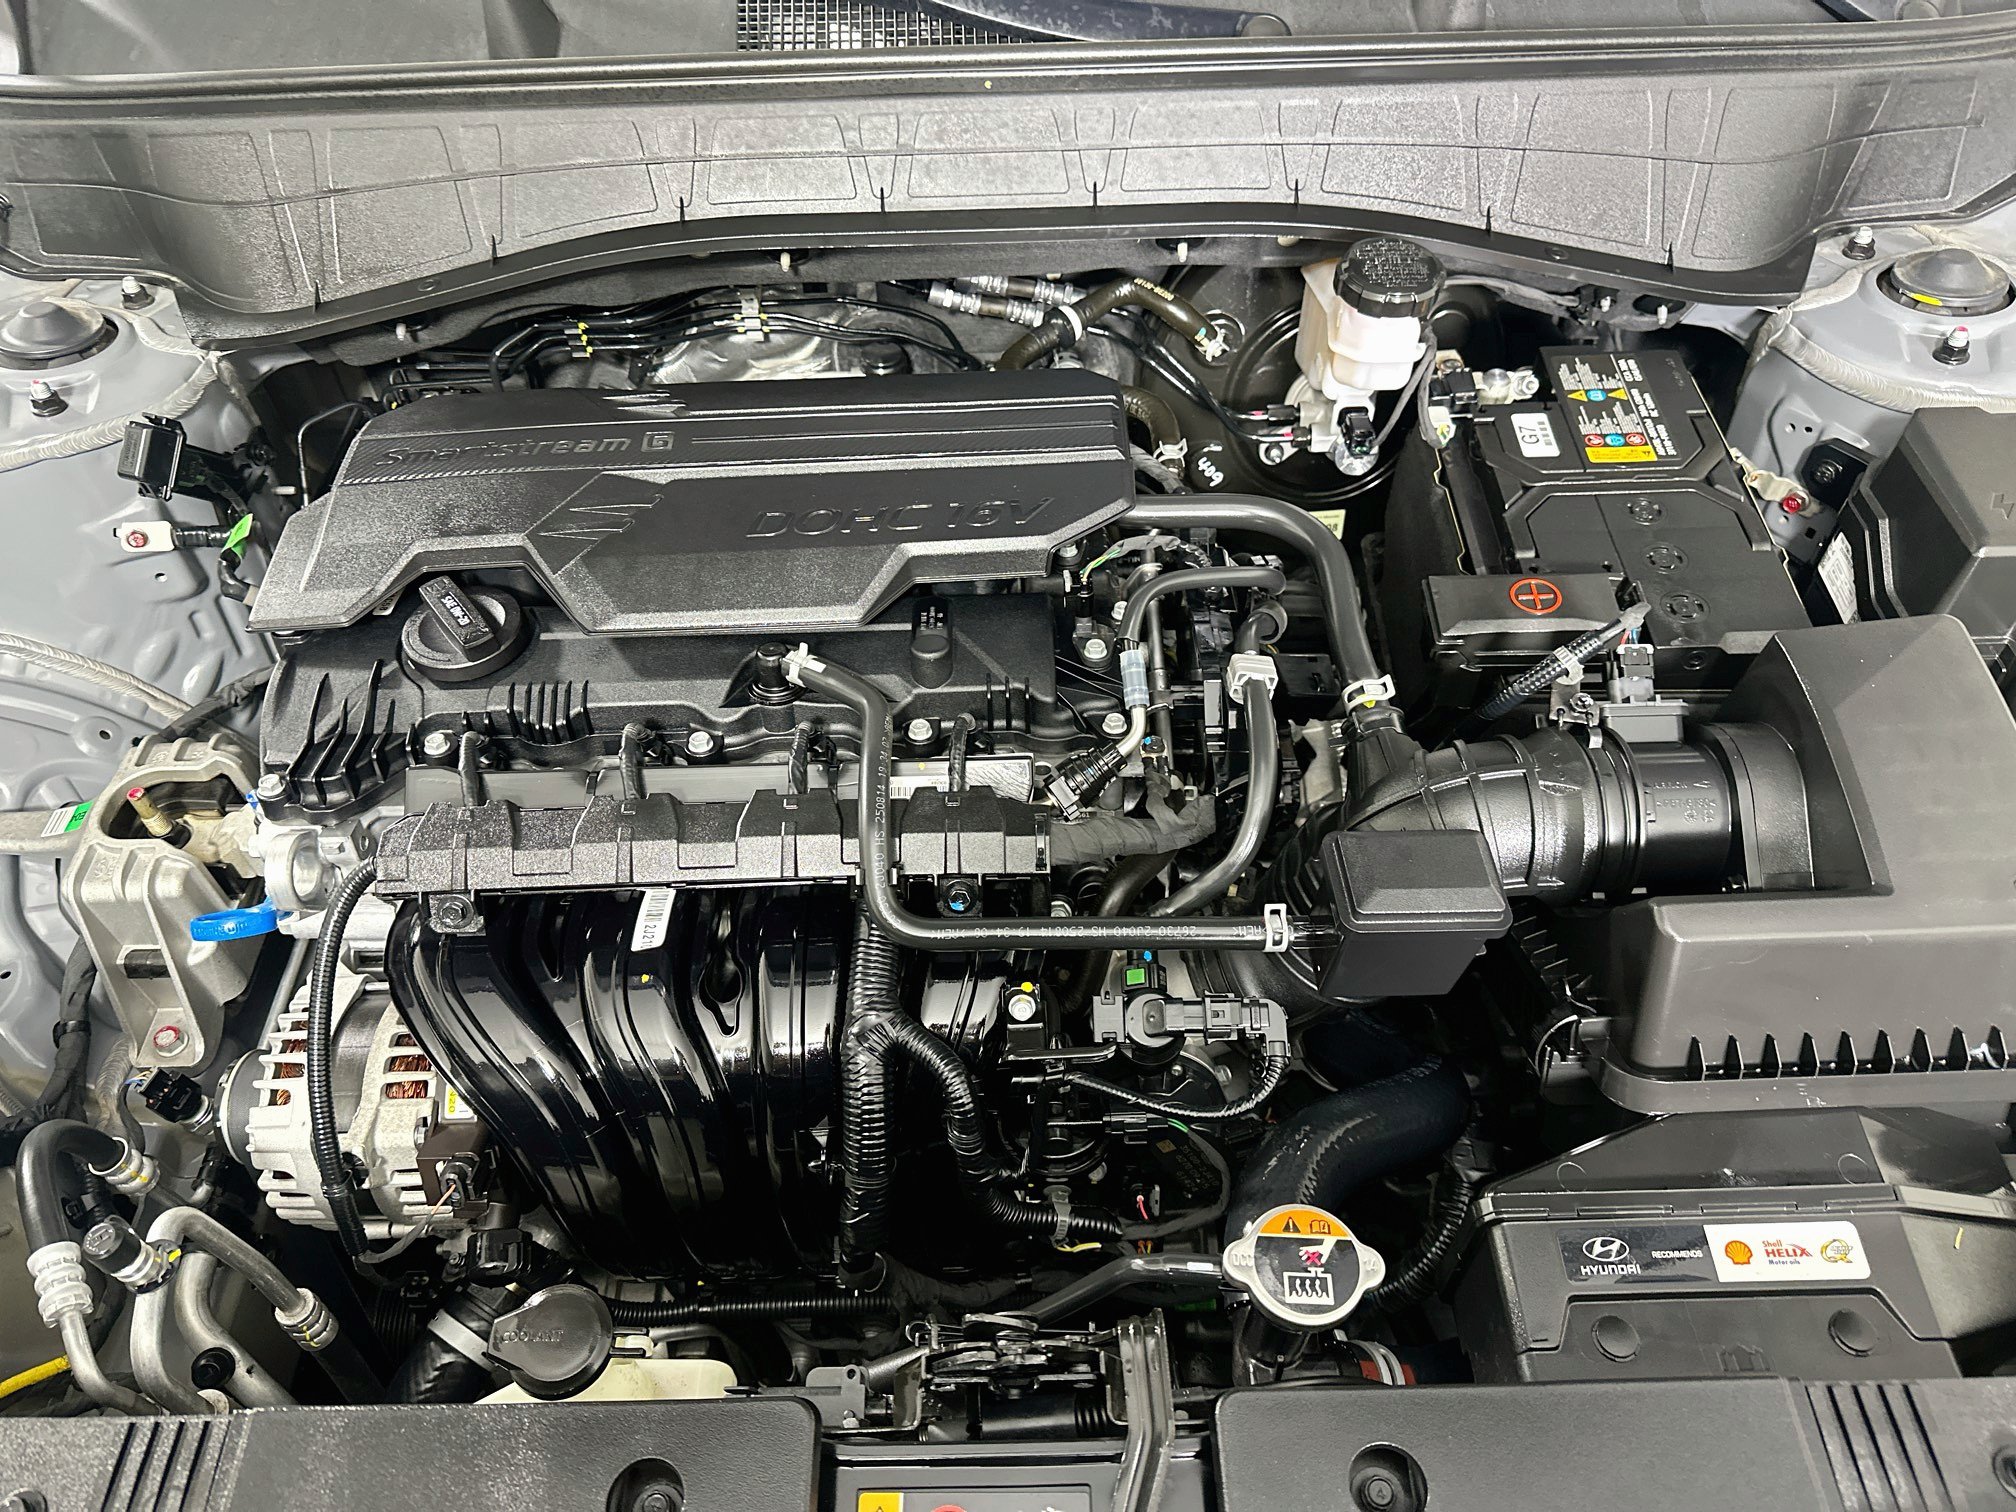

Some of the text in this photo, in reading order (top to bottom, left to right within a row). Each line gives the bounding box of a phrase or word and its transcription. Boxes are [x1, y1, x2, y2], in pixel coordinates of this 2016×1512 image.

[1518, 426, 1540, 446] G7
[375, 438, 632, 466] Smartstream
[1198, 456, 1224, 487] 409
[746, 497, 1056, 538] DOHC 16V
[440, 593, 473, 628] SAE 0W-20
[875, 784, 886, 824] 250814
[874, 830, 885, 846] HS
[1041, 925, 1084, 938] 250814
[1762, 1239, 1783, 1248] Shell
[1651, 1249, 1704, 1259] RECOMMENDS
[1765, 1246, 1812, 1258] HELIX
[1580, 1263, 1642, 1276] HYUNDAI
[502, 1329, 564, 1344] COOLANT
